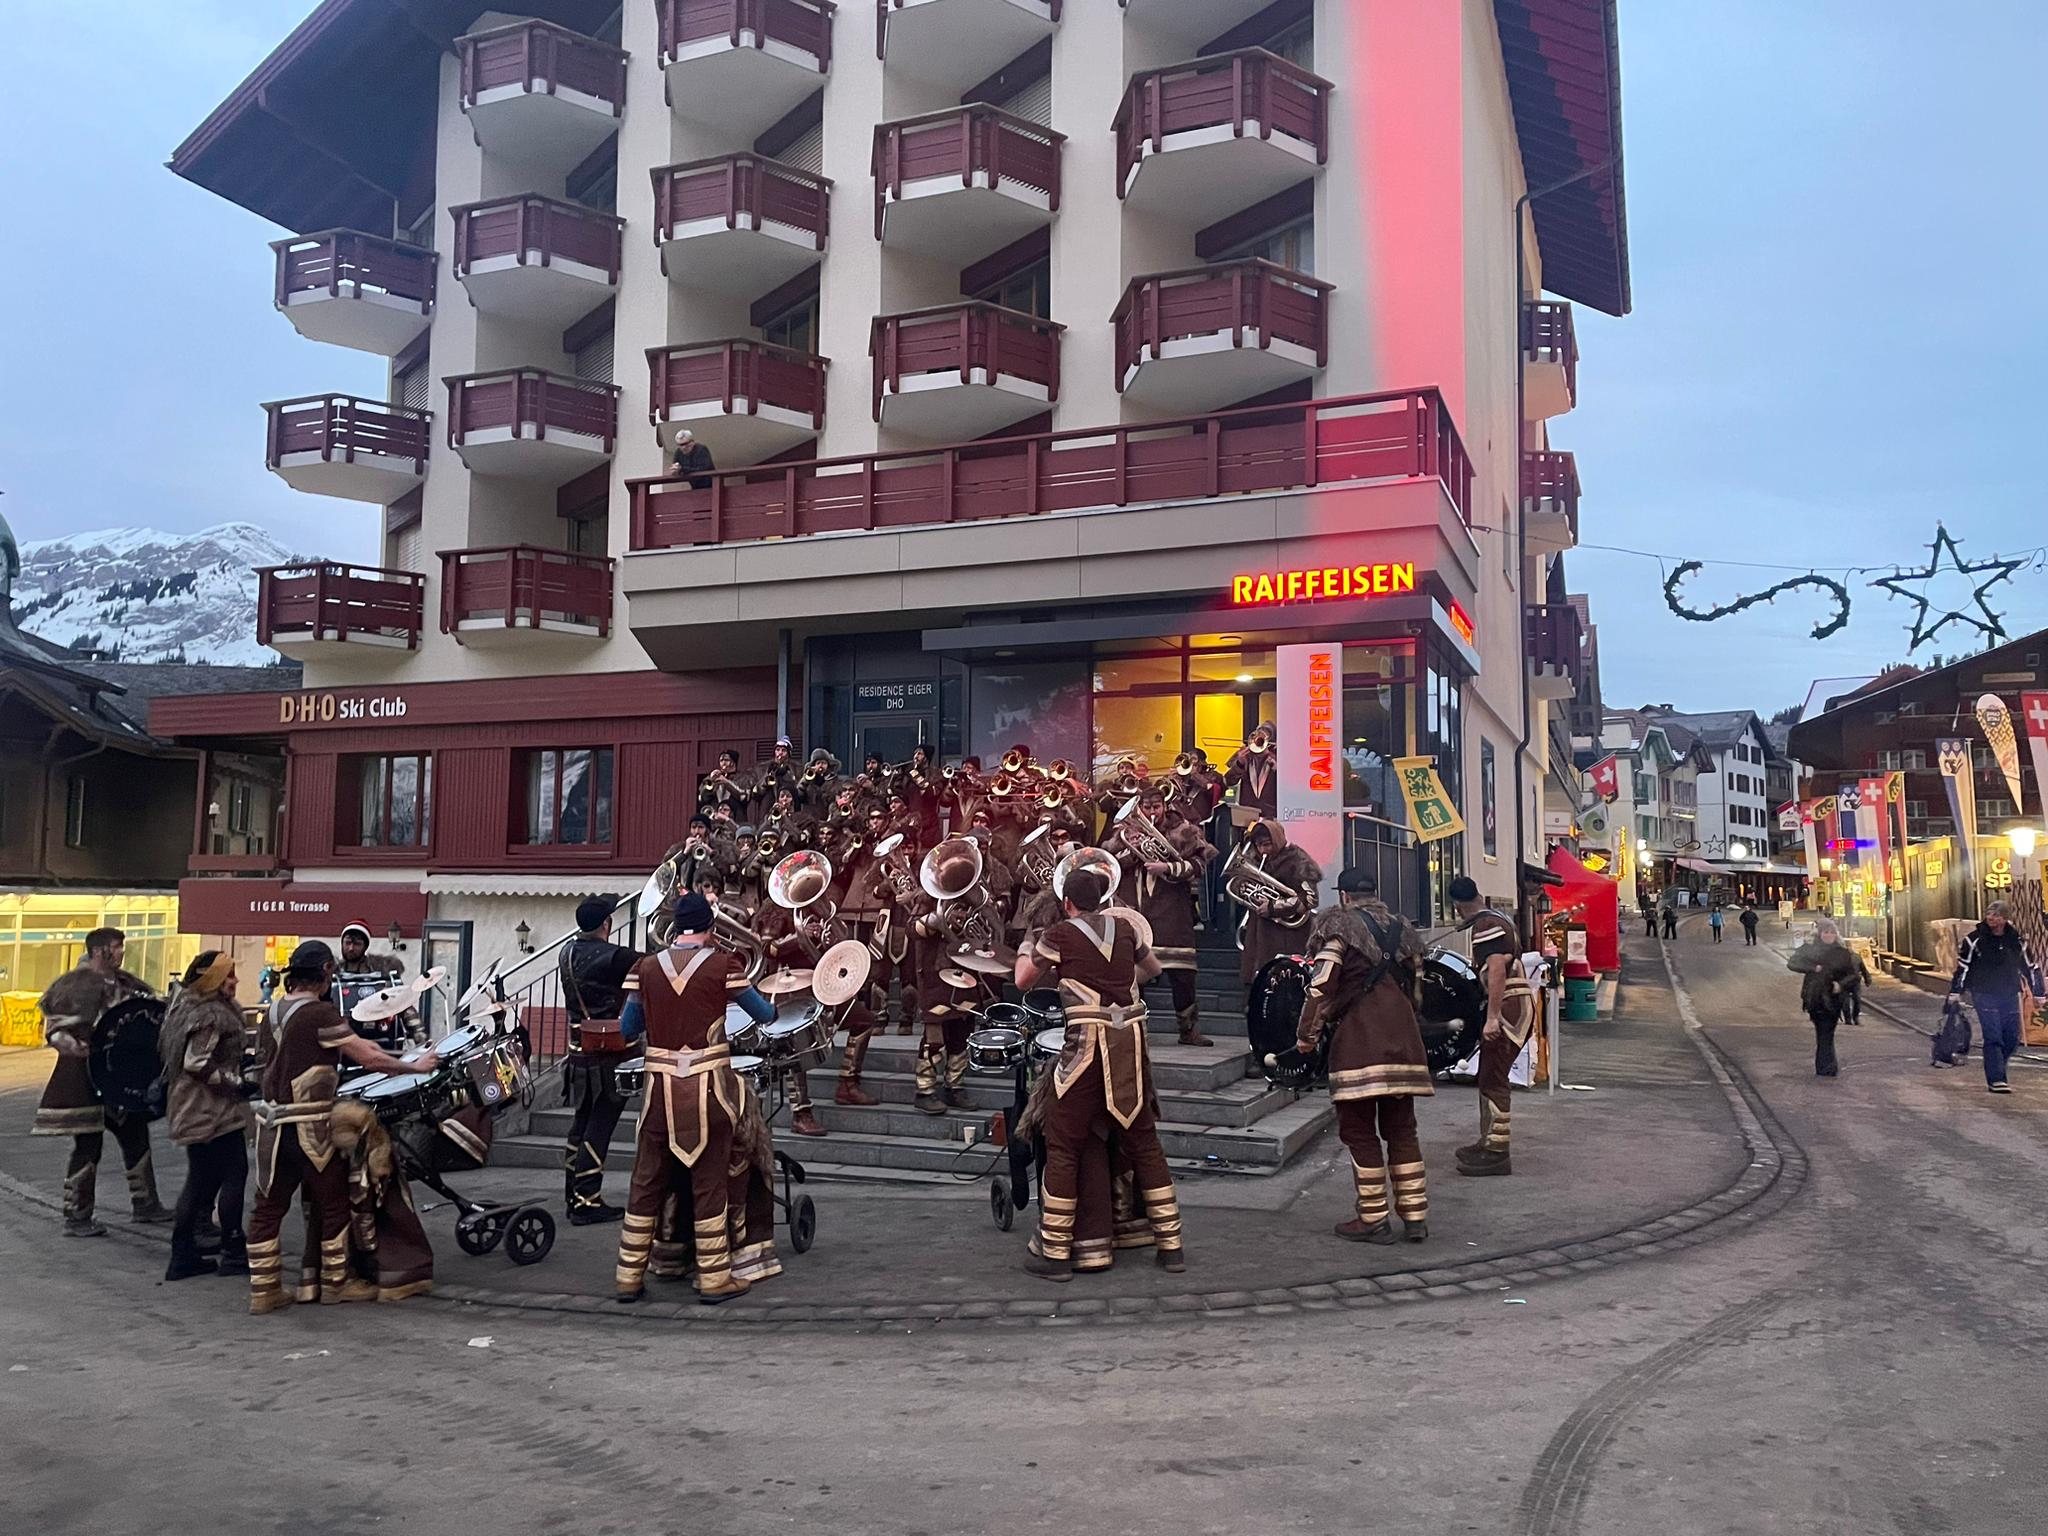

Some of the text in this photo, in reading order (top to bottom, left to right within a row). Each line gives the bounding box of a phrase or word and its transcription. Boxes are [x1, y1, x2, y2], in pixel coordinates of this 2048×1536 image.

[1233, 563, 1414, 603] RAIFFEISEN
[859, 684, 932, 697] RESIDENCE EIGER
[339, 698, 365, 719] Ski
[369, 696, 407, 718] Club
[887, 698, 904, 709] DHO
[1309, 653, 1333, 791] RAIFFEISEN
[250, 901, 330, 912] EIGER Terrasse
